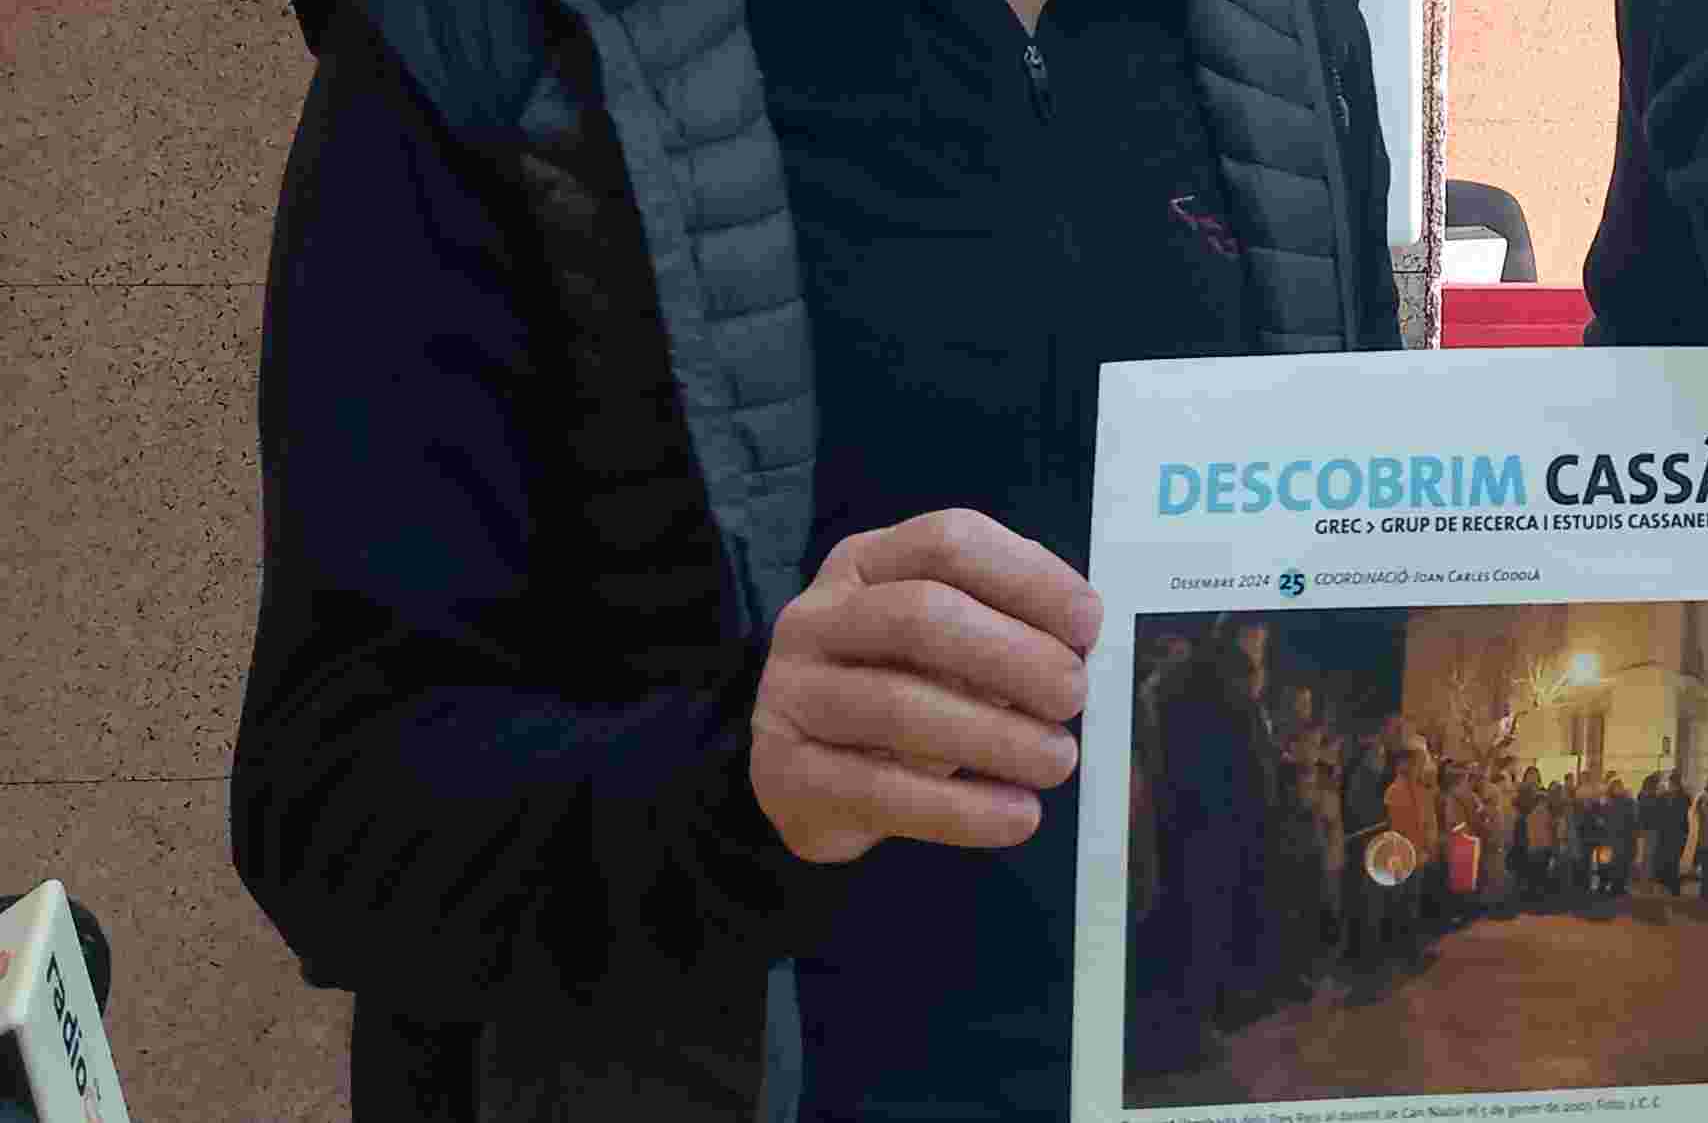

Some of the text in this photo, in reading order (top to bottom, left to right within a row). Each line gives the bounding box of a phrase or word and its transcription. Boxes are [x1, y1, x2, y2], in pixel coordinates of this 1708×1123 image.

[1158, 454, 1528, 515] DESCOBRIM
[1314, 518, 1362, 534] GREC
[1380, 517, 1430, 533] GRUP
[1434, 516, 1457, 532] DE
[1462, 515, 1539, 532] RECERCA
[1543, 515, 1549, 530] I
[1553, 513, 1624, 530] ESTUDIS
[1278, 573, 1305, 595] 25
